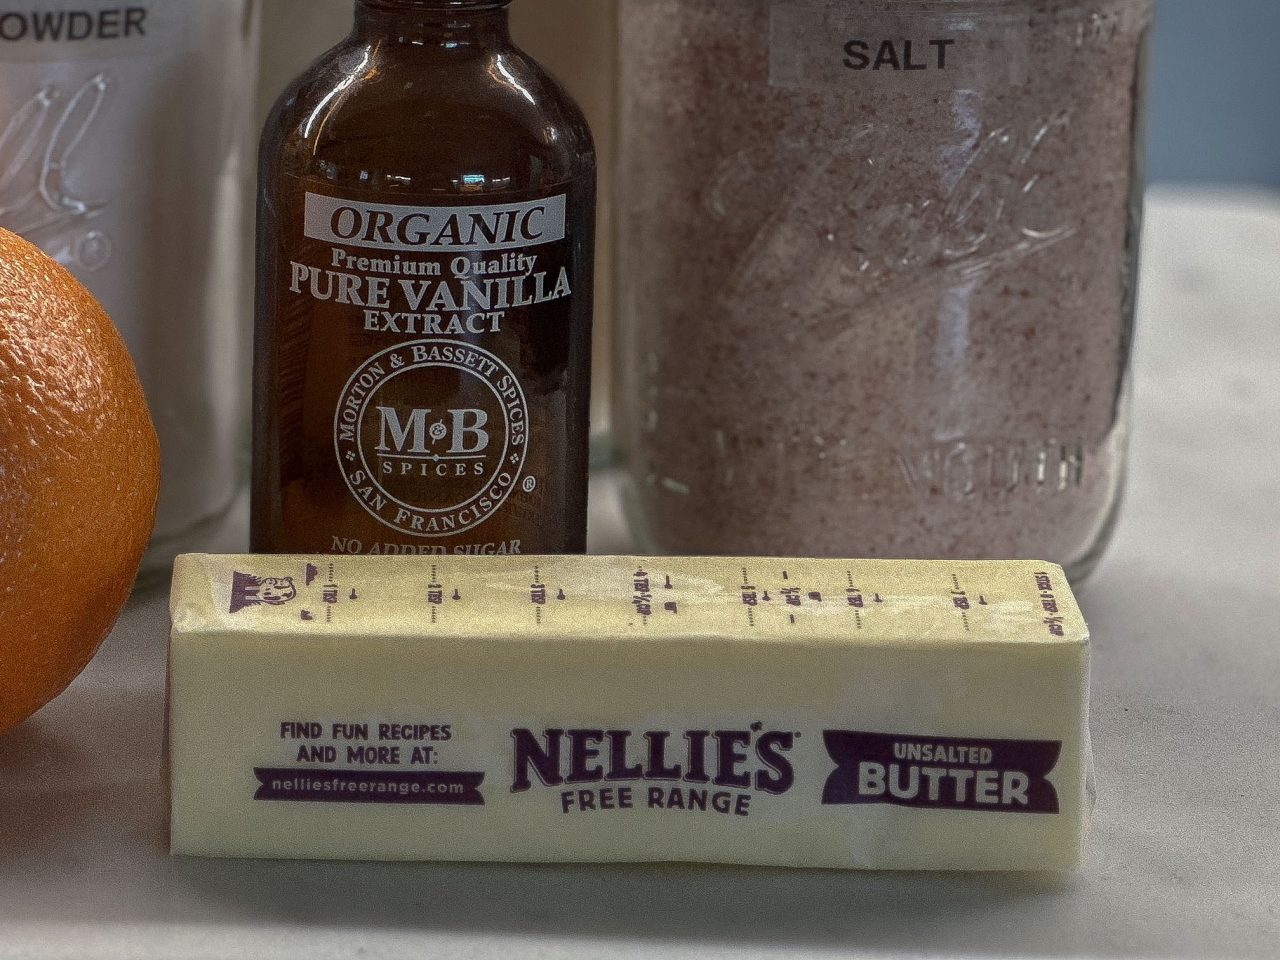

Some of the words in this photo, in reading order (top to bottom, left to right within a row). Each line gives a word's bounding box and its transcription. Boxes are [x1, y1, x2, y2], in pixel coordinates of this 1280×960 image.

[842, 39, 956, 71] SALT
[329, 205, 546, 247] ORGANIC
[331, 247, 442, 277] Premium
[450, 253, 538, 279] Quality
[289, 260, 391, 309] PURE
[399, 266, 572, 312] VANILLA
[363, 309, 505, 335] EXTRACT
[340, 362, 386, 442] MORTON
[390, 353, 405, 369] &
[411, 345, 499, 378] BASSETT
[496, 375, 525, 446] SPICES
[382, 461, 485, 477] SPICES
[350, 470, 388, 511] SAN
[393, 472, 512, 532] FRANCISCO
[331, 537, 362, 554] NO
[370, 543, 447, 555] ADDED
[454, 540, 520, 555] SUGAR
[280, 721, 322, 739] FIND
[332, 723, 369, 740] FUN
[378, 724, 452, 741] RECIPES
[296, 745, 337, 763] AND
[346, 746, 401, 765] MORE
[410, 746, 438, 765] AT:
[510, 722, 797, 795] NELLIE'S
[893, 742, 993, 765] UNSALTED
[271, 777, 464, 795] nelliesfreerange.com
[857, 761, 1030, 805] BUTTER
[561, 786, 634, 814] FREE
[647, 787, 752, 817] RANGE
